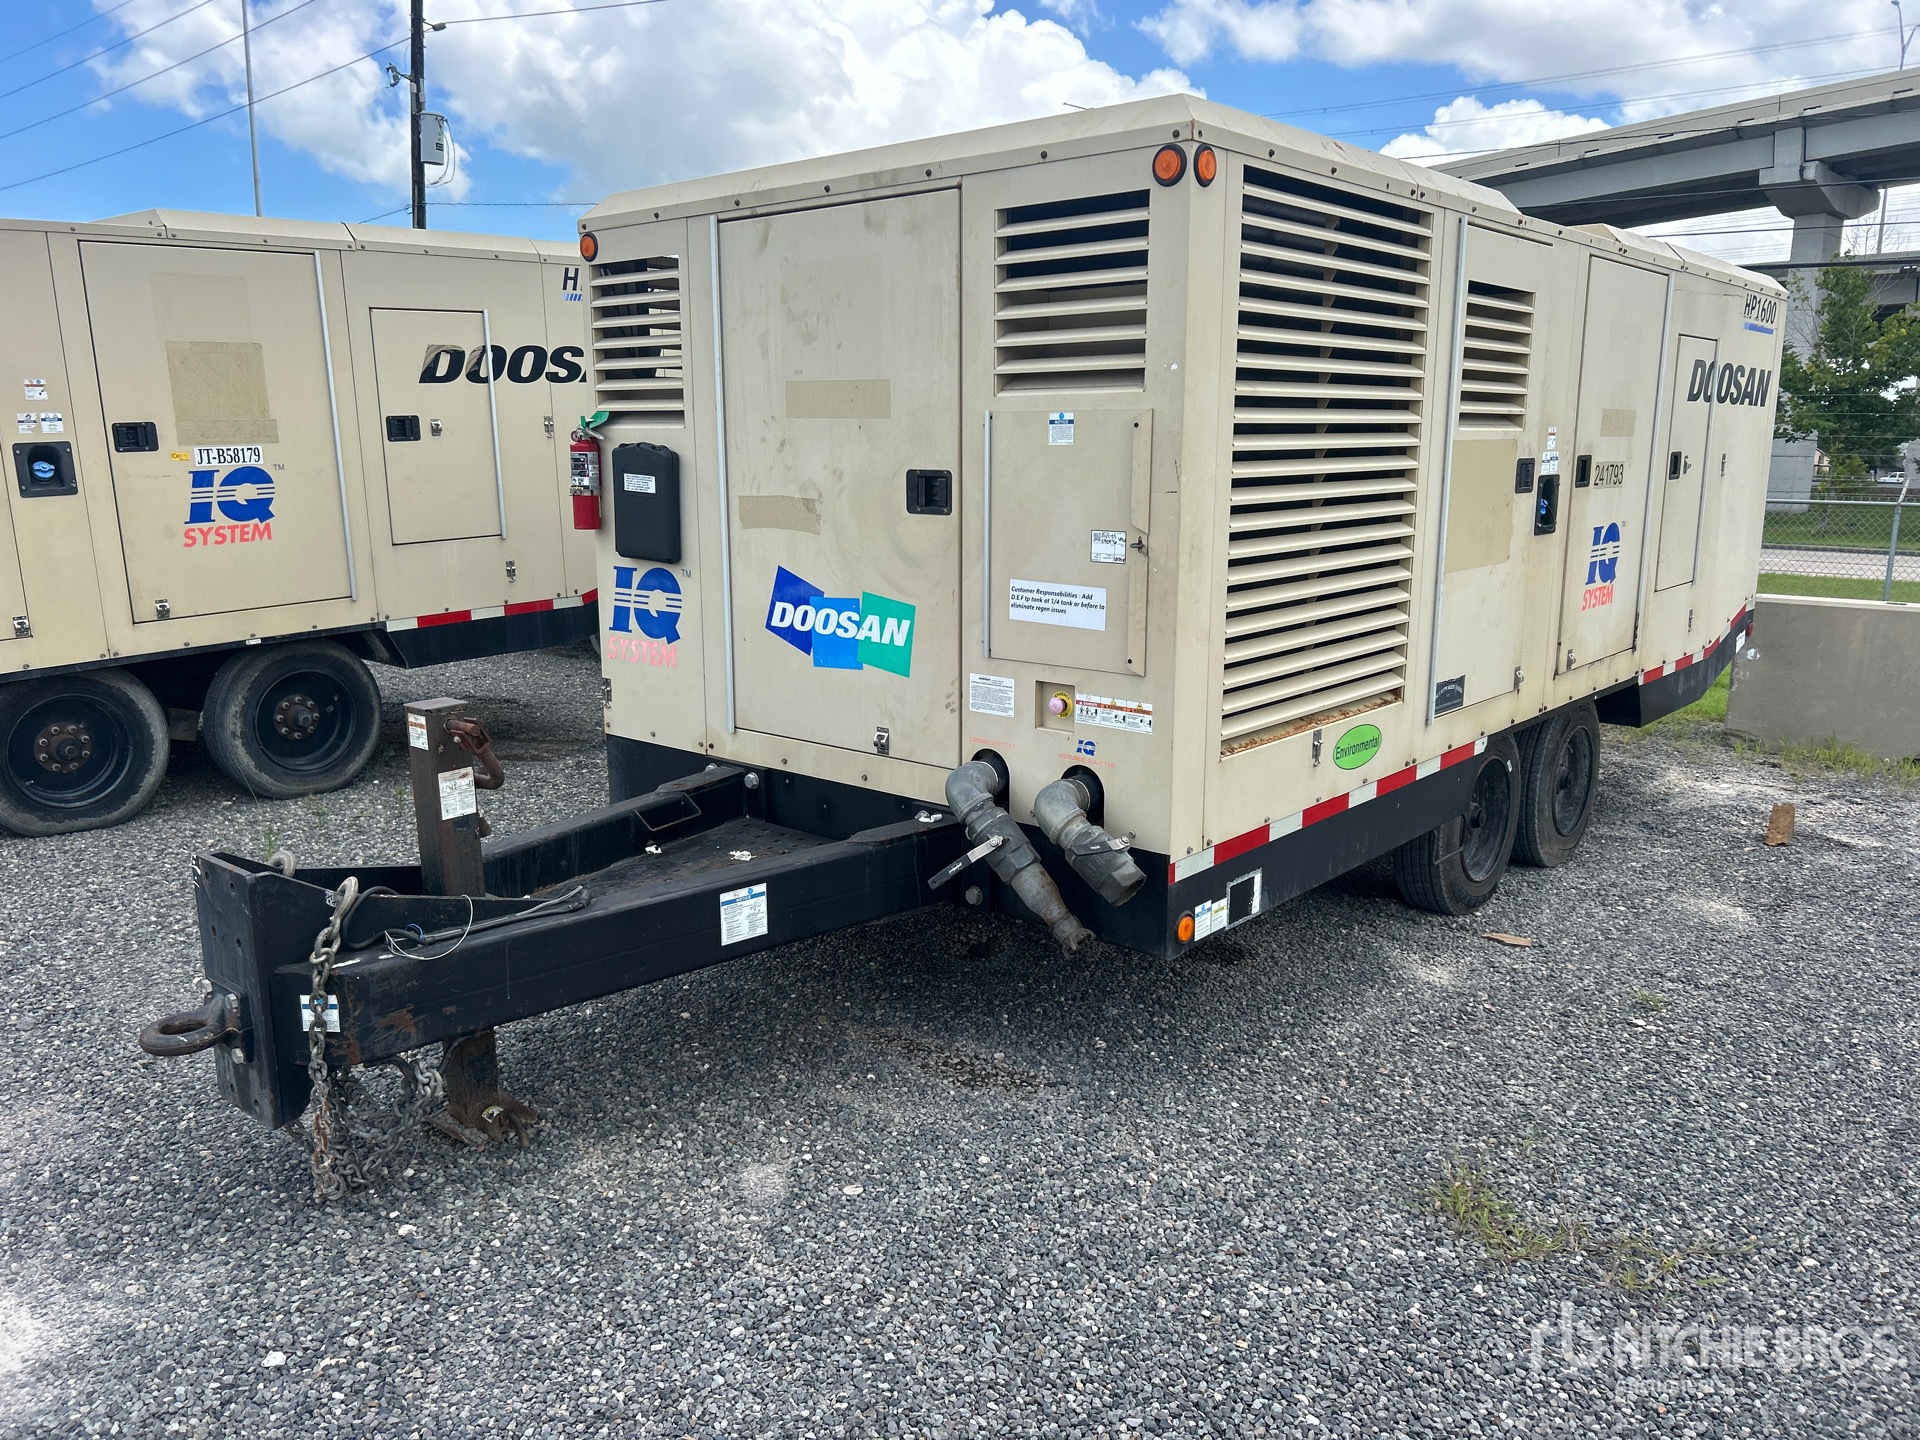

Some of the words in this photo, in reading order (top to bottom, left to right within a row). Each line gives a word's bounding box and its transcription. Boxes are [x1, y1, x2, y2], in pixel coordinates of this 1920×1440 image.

[1743, 293, 1777, 325] HP1600
[419, 345, 587, 384] DOOS
[1687, 359, 1772, 408] DOOSAN
[197, 447, 261, 465] JT-B58179
[1593, 464, 1624, 486] 241793
[184, 466, 275, 524] IQ
[183, 522, 273, 548] SYSTEM
[1585, 522, 1620, 585] IQ
[1011, 586, 1035, 594] Customer
[1581, 584, 1614, 611] SYSTEM
[609, 566, 682, 645] IQ
[1011, 602, 1035, 610] eliminate
[1035, 605, 1050, 613] regen
[770, 601, 911, 647] DOOSAN
[608, 635, 678, 669] SYSTEM
[1076, 739, 1096, 757] IQ
[1335, 734, 1380, 761] Environmental
